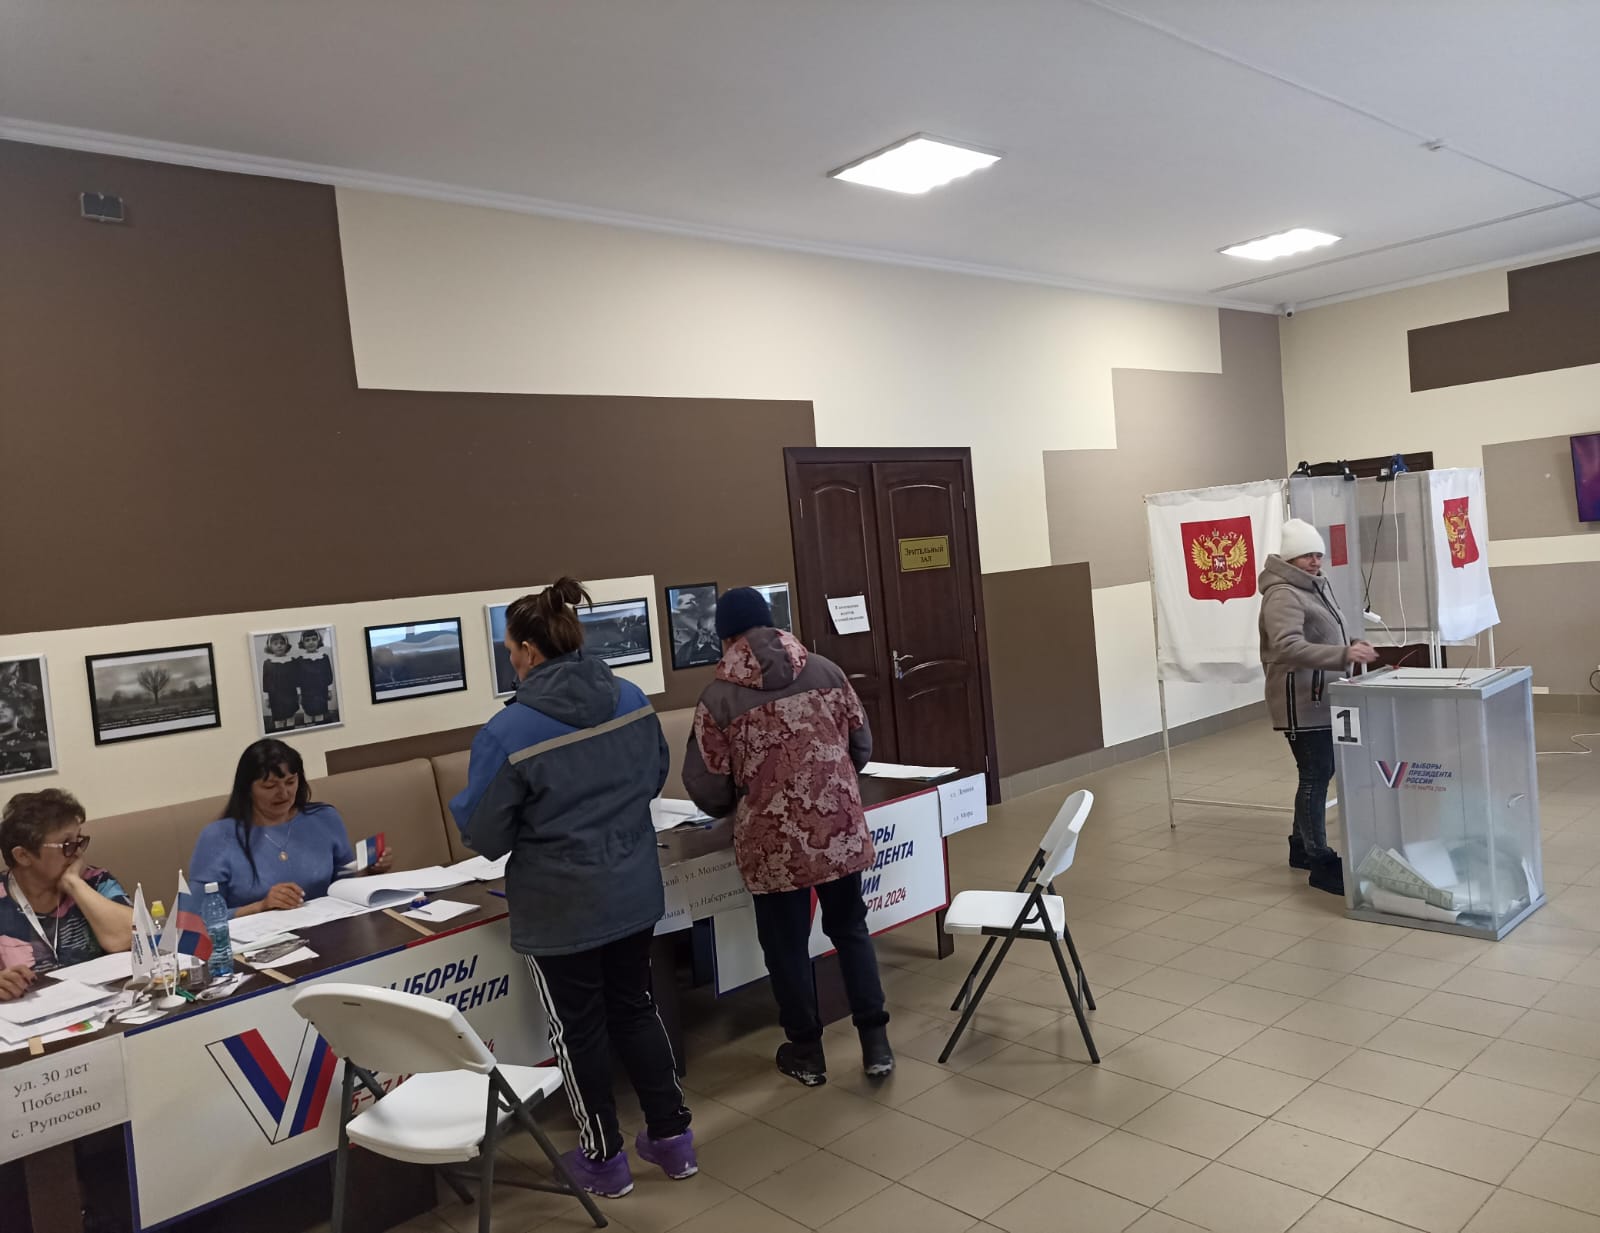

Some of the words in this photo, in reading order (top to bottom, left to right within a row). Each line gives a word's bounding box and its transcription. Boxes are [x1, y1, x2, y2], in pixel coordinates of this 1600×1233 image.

[1336, 709, 1358, 743] 1
[13, 1080, 37, 1097] ул.
[41, 1069, 60, 1085] 30
[64, 1062, 90, 1078] лет
[11, 1127, 24, 1139] с.
[29, 1101, 102, 1133] Рупосово
